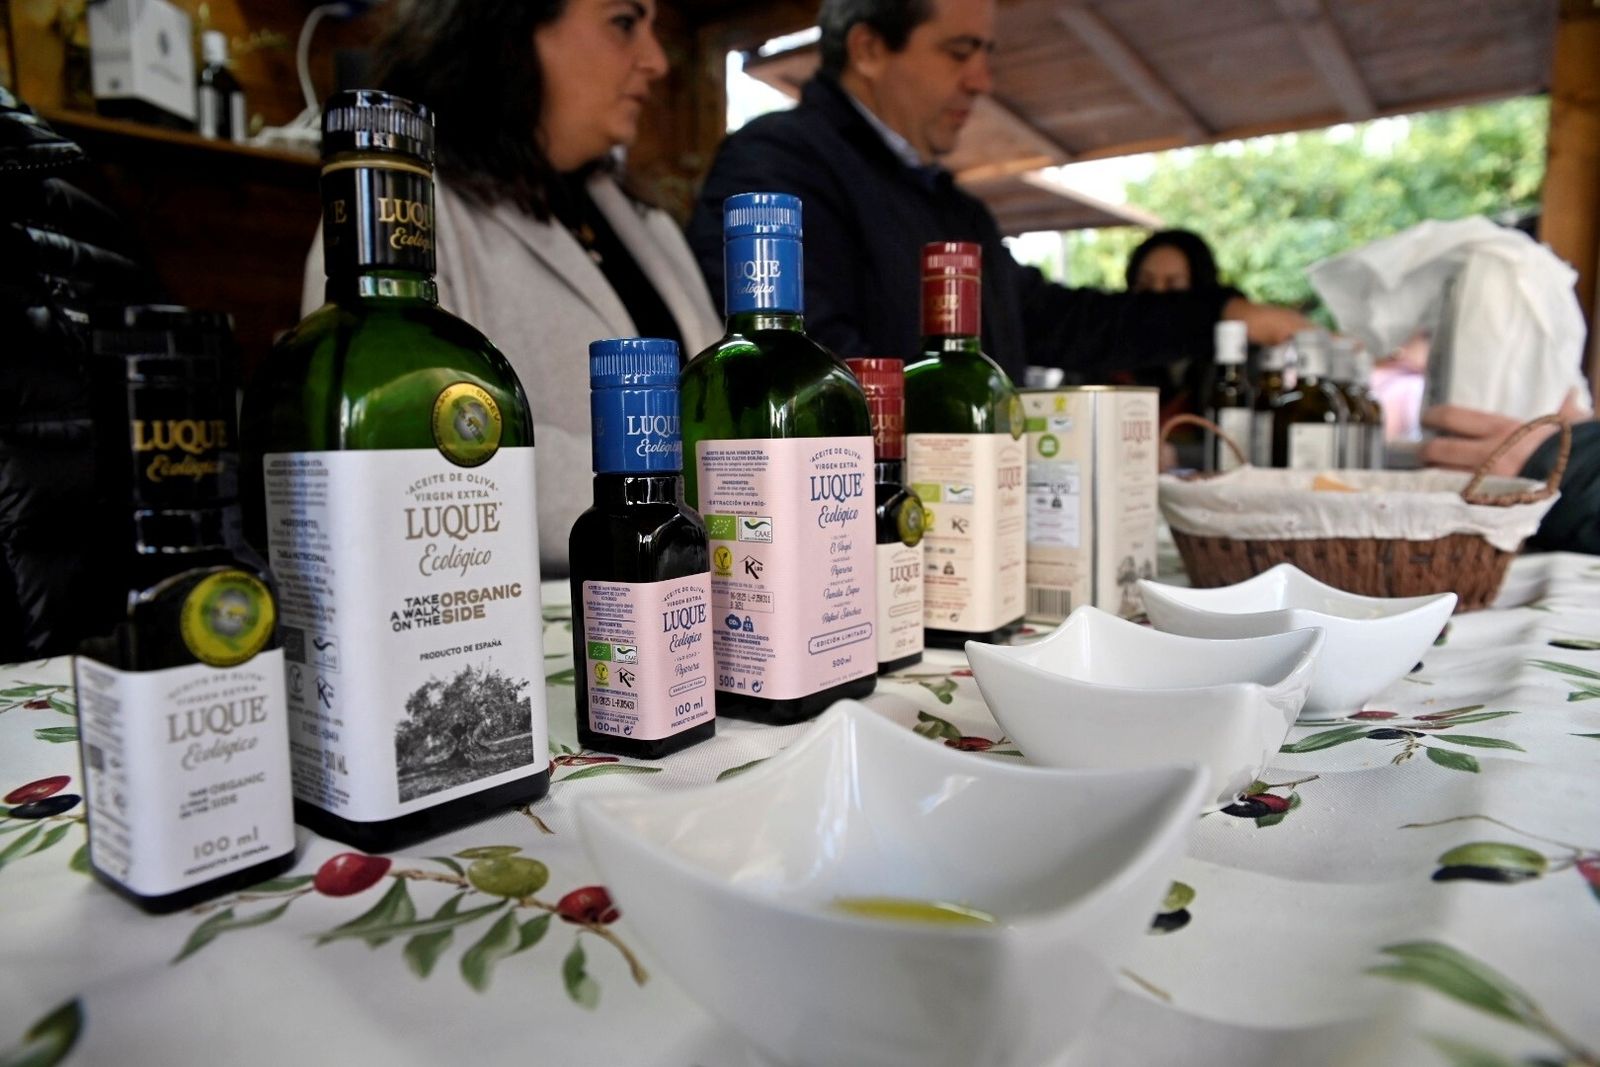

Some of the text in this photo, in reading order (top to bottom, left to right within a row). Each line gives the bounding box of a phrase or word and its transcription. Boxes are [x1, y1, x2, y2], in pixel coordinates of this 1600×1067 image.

[811, 448, 832, 463] ACEITE
[844, 448, 861, 461] OLIVA
[815, 461, 858, 470] VIRGEN EXTRA
[408, 473, 496, 494] ACEITE DE OLIVA
[810, 472, 863, 503] LUQUE
[415, 489, 490, 502] VIRGEN EXTRA
[404, 502, 500, 541] LUQUE
[818, 505, 858, 529] Ecológico
[419, 543, 492, 578] Ecológico
[404, 583, 522, 608] TAKE ORGANIC
[390, 606, 441, 622] A WALK
[392, 605, 486, 633] ON THE SIDE
[663, 603, 706, 633] LUQUE
[419, 638, 502, 661] PRODUCTO DE ESPAÑA
[815, 630, 867, 648] EDICIÓN LIMITADA
[719, 675, 746, 689] 500 ml
[675, 696, 703, 717] 100 ml
[166, 695, 268, 744] LUQUE
[193, 826, 258, 860] 100 ml
